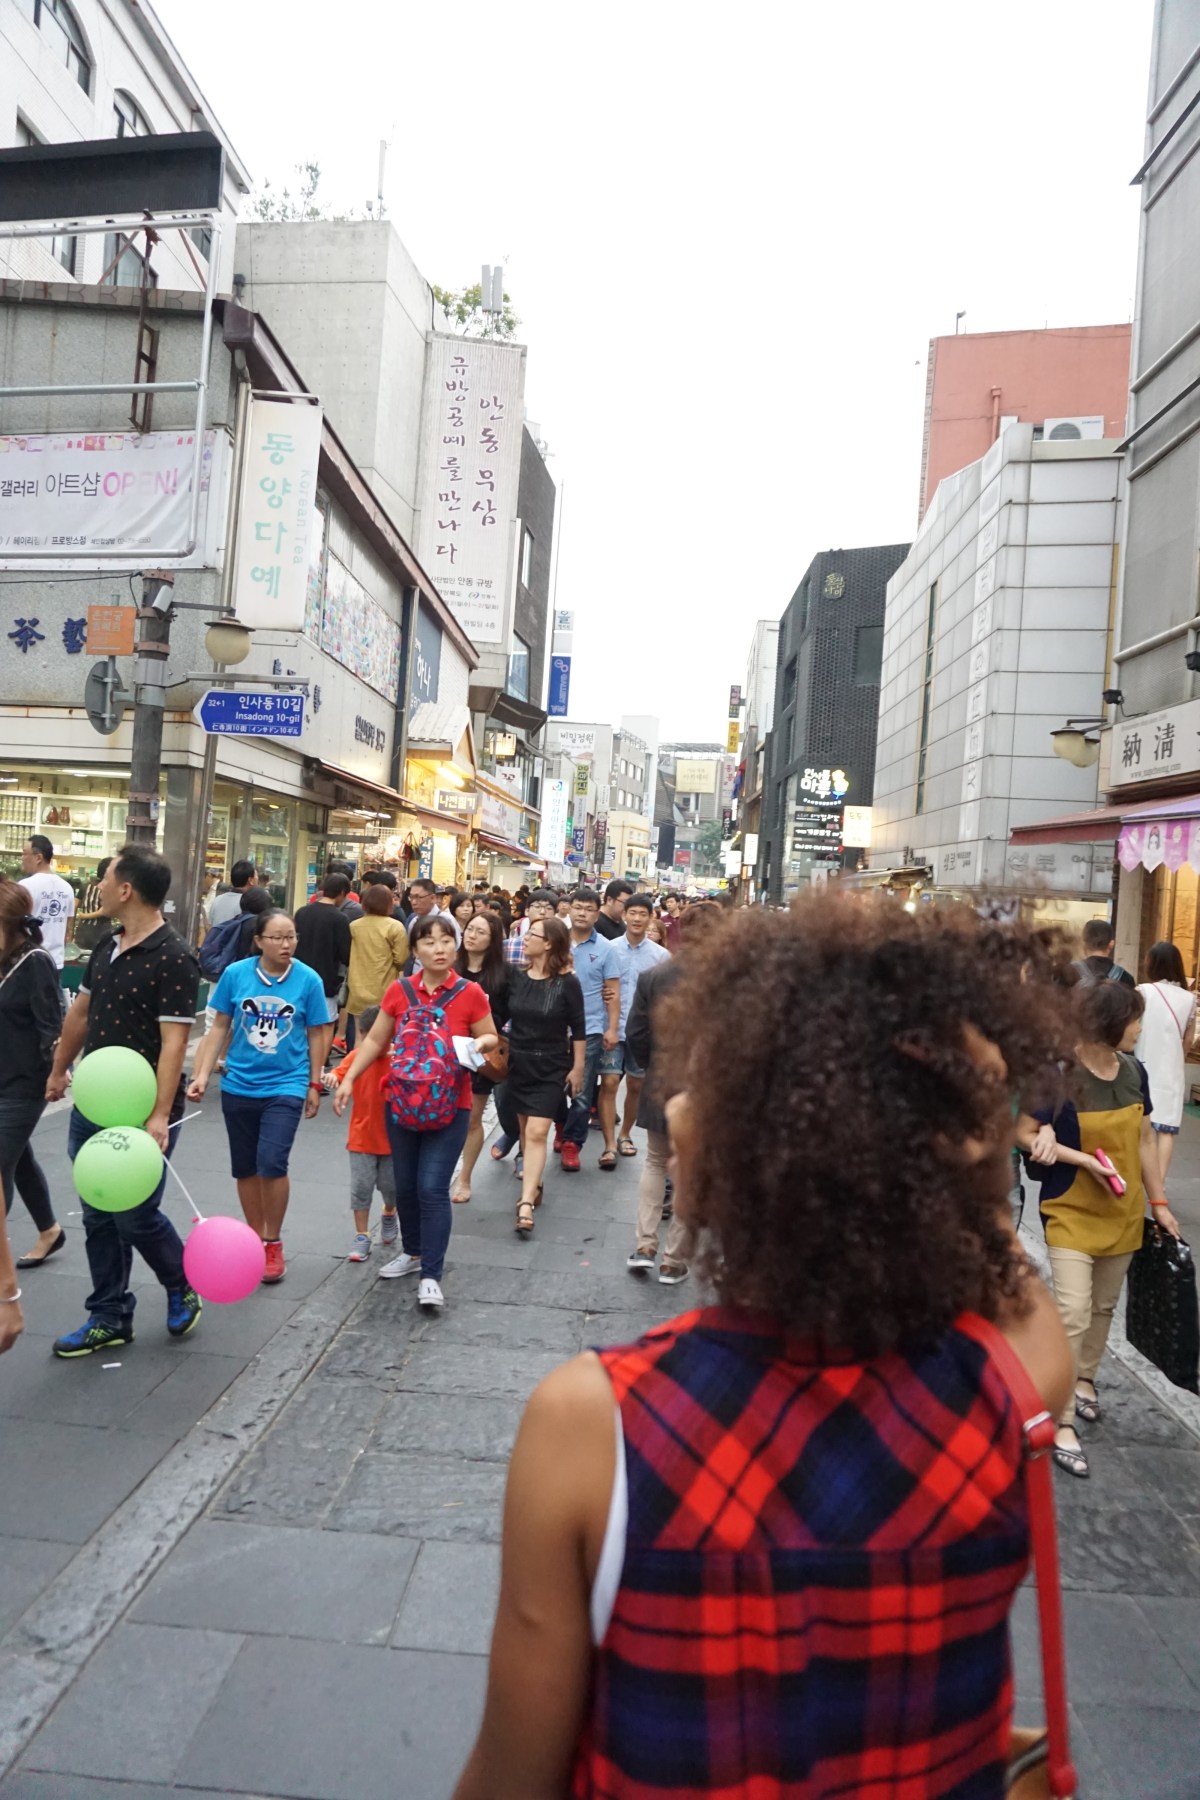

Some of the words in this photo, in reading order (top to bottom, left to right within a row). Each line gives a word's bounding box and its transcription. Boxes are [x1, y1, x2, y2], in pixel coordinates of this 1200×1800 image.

[479, 395, 505, 453] 안동
[46, 472, 101, 497] 아트샵
[250, 432, 295, 599] 동양다예
[457, 576, 474, 586] 안동
[476, 578, 493, 588] 규방
[239, 696, 301, 712] 인사동10길
[235, 711, 273, 722] Insadong
[276, 713, 300, 724] 10-gil
